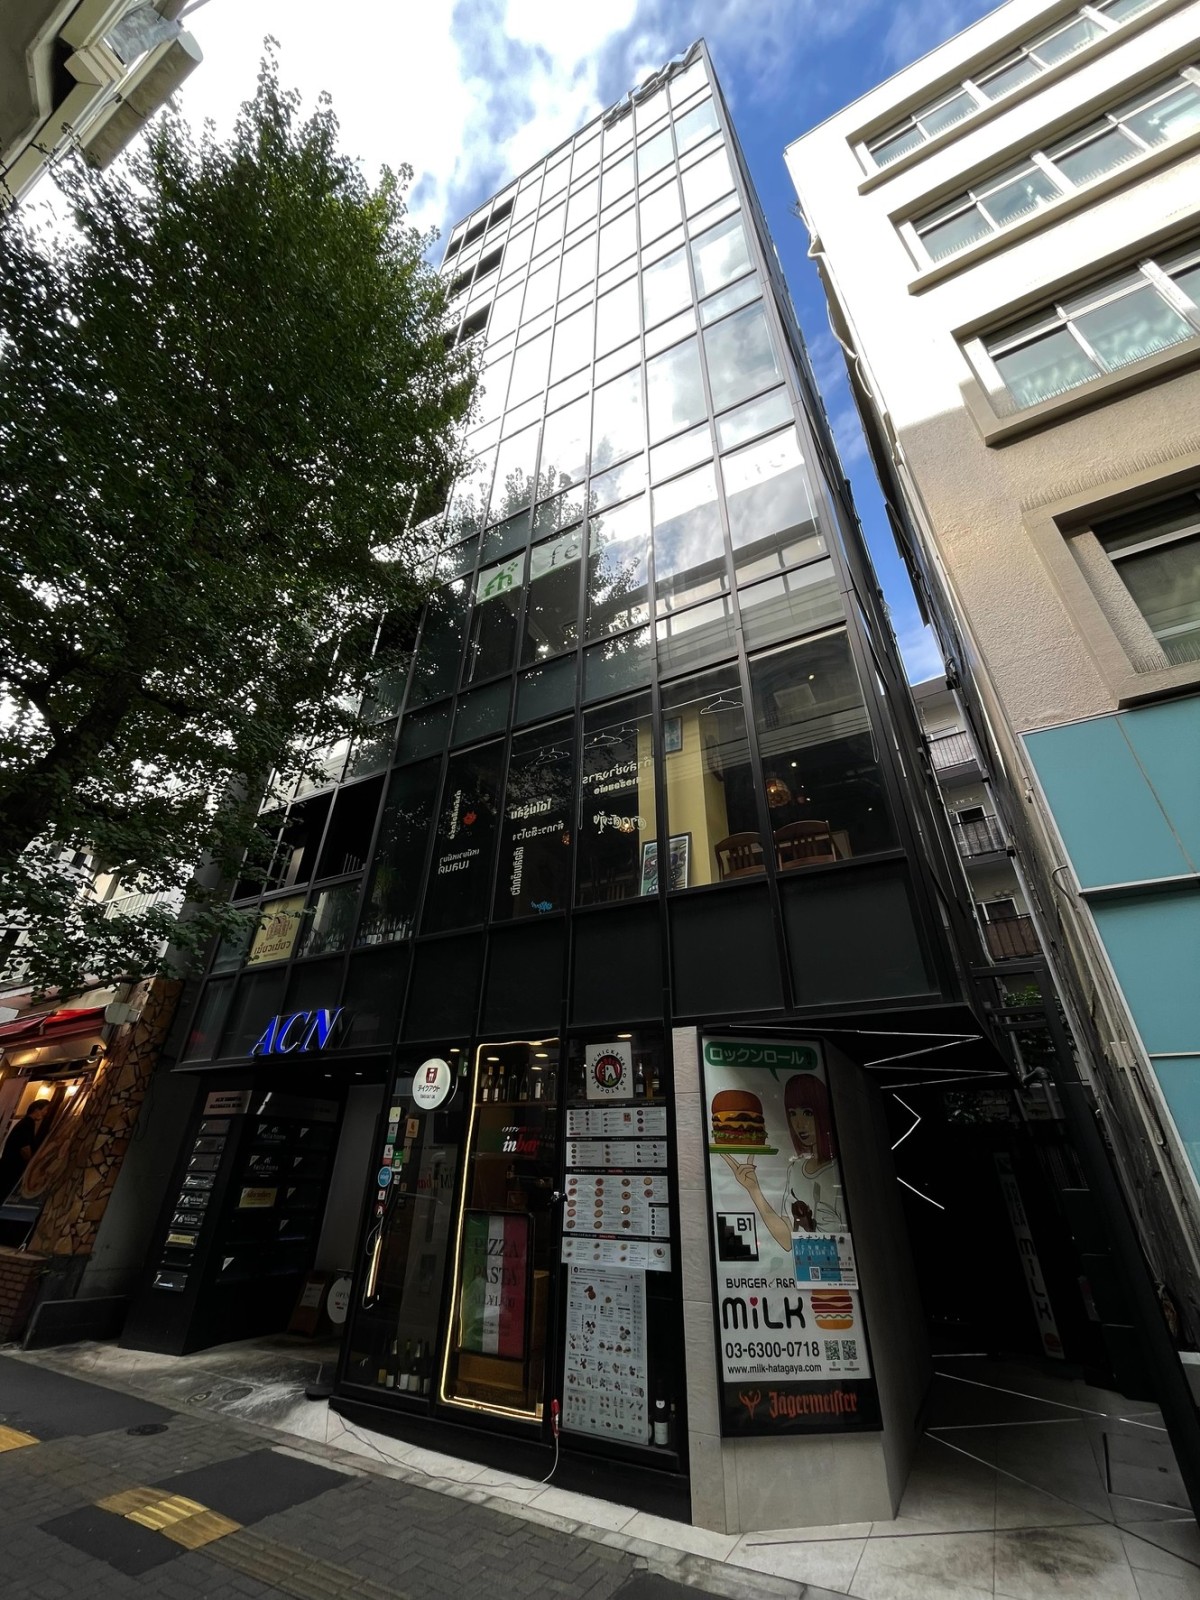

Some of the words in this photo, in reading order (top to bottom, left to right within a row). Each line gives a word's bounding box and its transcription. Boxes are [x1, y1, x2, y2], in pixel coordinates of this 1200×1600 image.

[249, 1006, 345, 1056] ACN
[709, 1047, 805, 1066] ロックンロール
[736, 1217, 752, 1232] B1
[726, 1278, 768, 1289] BURGER
[725, 1341, 820, 1358] 03-6300-0718
[727, 1363, 822, 1375] www.milk-hatagaya.com
